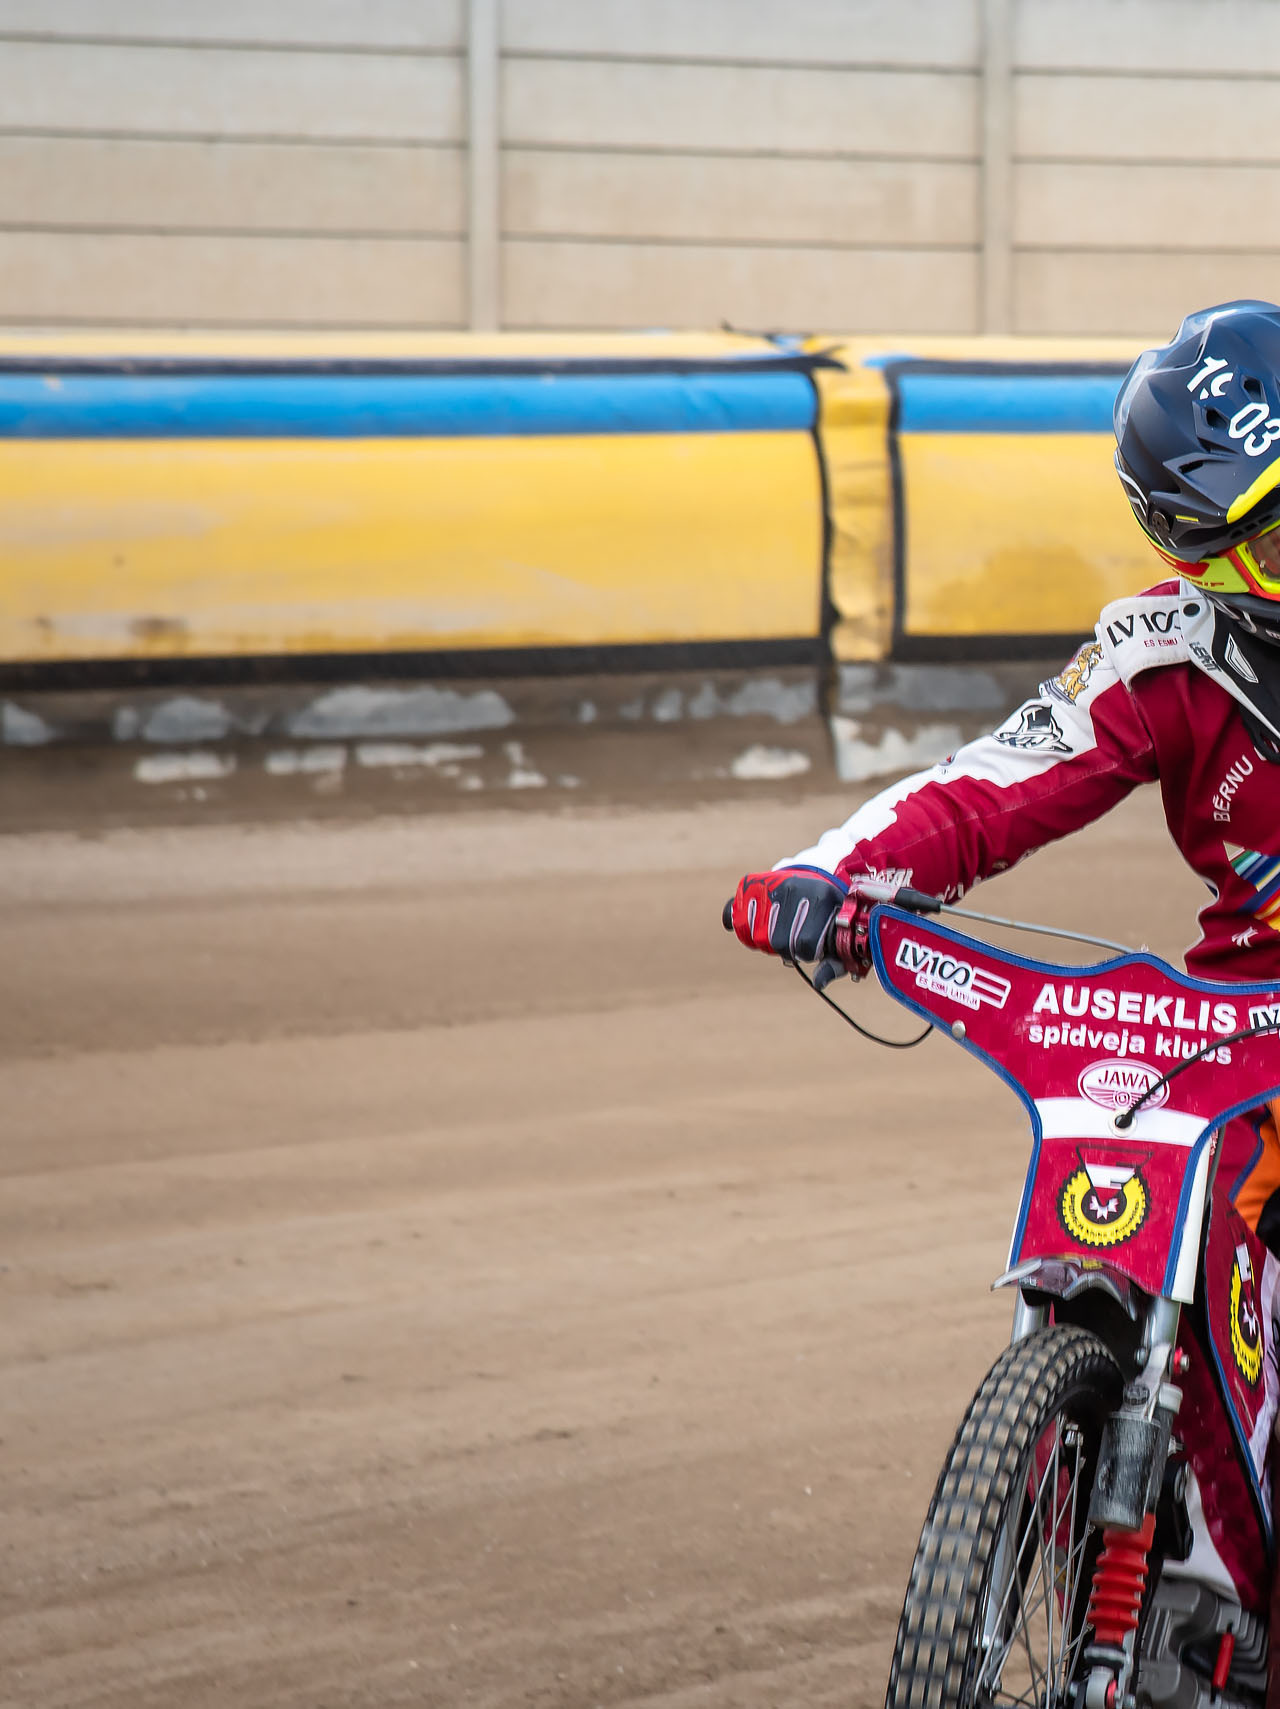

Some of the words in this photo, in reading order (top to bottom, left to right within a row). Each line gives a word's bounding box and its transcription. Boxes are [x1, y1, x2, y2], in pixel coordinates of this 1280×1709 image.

[1032, 983, 1237, 1034] AUSEKLIS
[1028, 1022, 1146, 1057] spīdveja
[1155, 1033, 1232, 1065] klubs
[1098, 1069, 1151, 1092] JAWA
